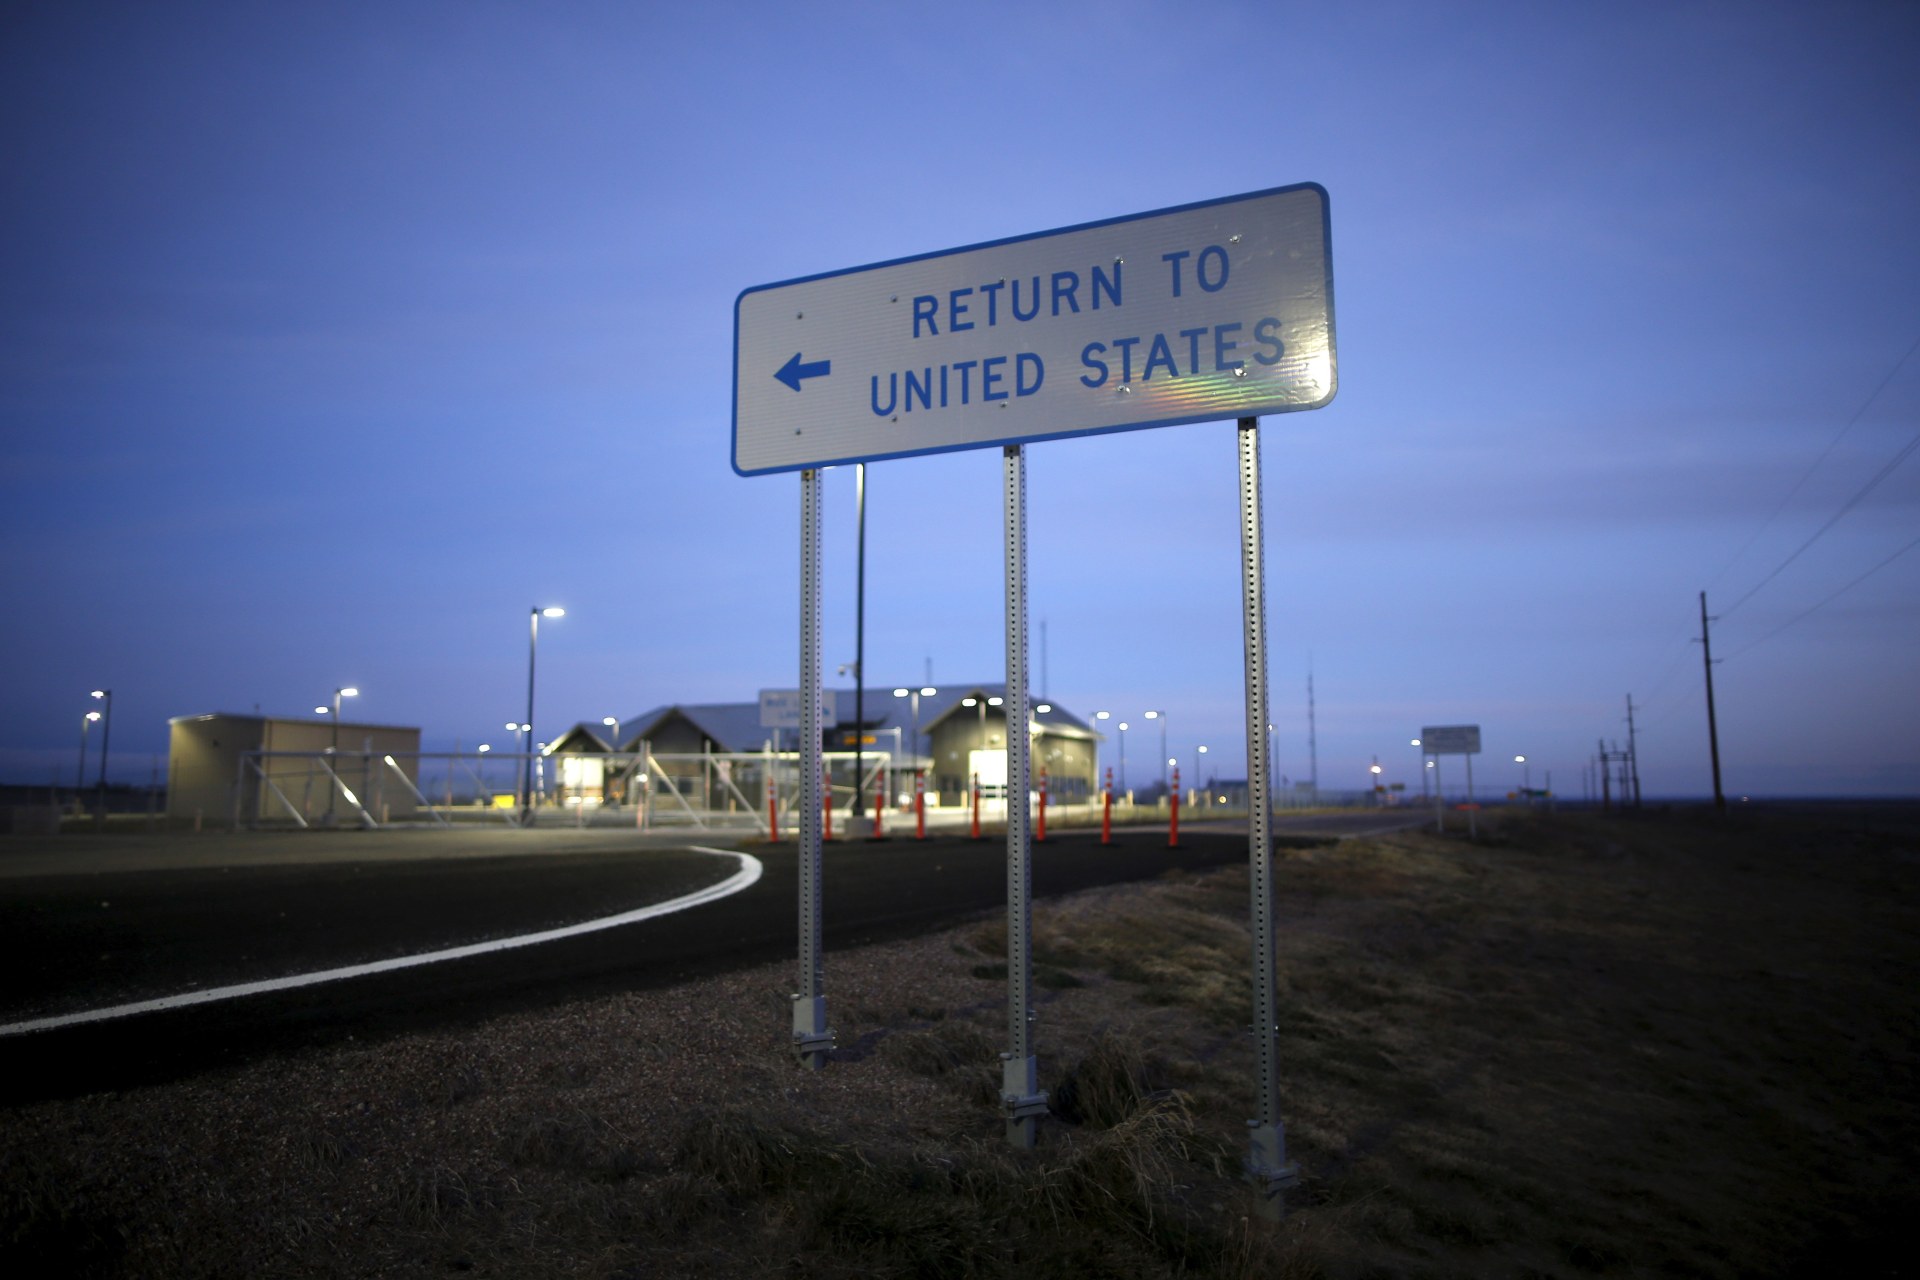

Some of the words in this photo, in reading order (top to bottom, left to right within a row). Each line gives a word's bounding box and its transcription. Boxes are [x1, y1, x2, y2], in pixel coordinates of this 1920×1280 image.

[912, 263, 1124, 338] RETURN
[1161, 244, 1231, 299] TO
[870, 351, 1046, 418] UNITED
[1080, 317, 1286, 388] STATES
